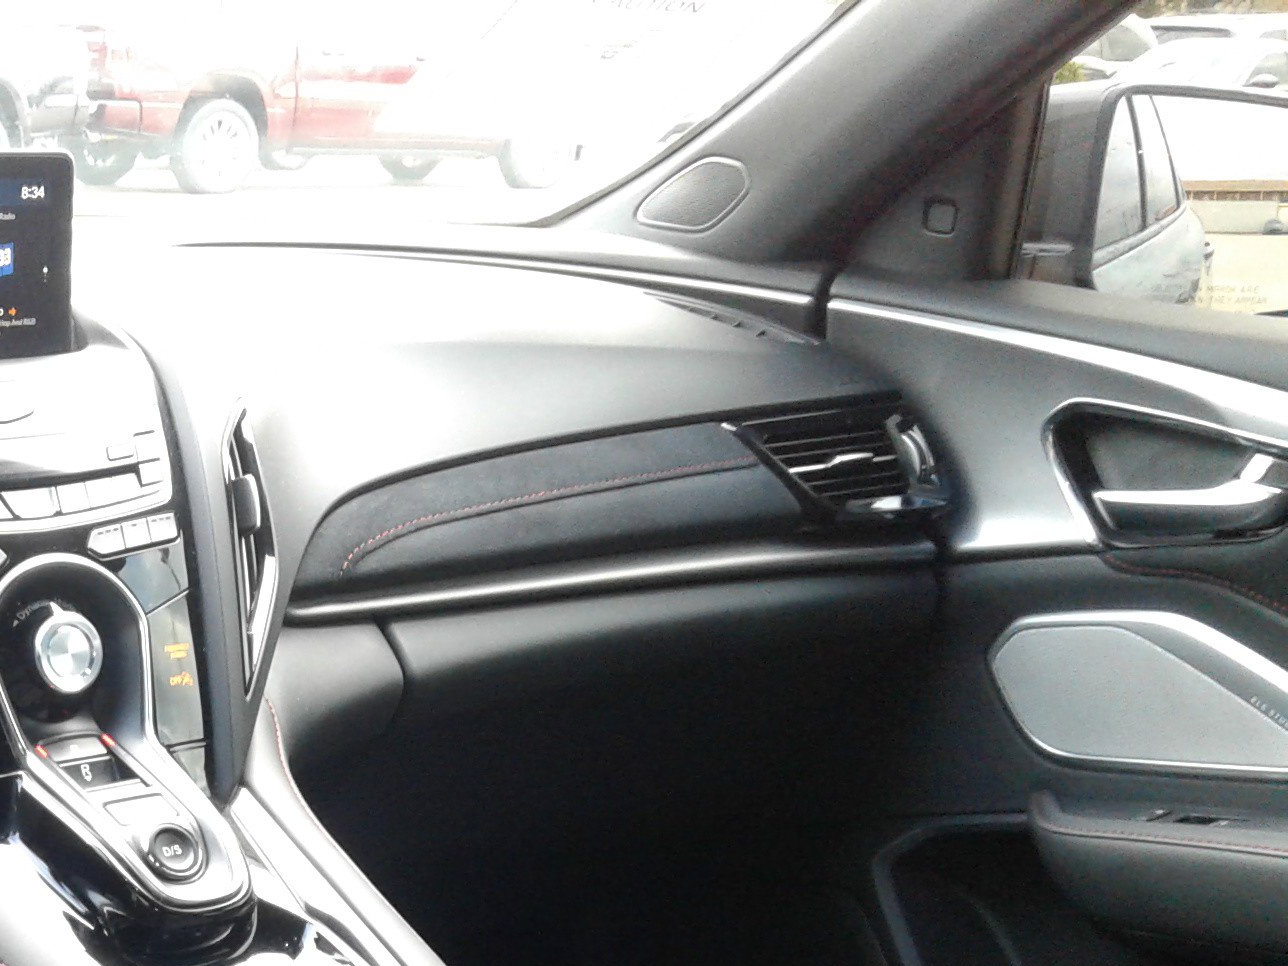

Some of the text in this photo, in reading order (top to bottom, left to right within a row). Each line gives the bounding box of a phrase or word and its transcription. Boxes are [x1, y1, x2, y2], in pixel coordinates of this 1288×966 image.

[21, 185, 45, 199] 8:34
[0, 211, 16, 221] Radio
[162, 844, 182, 857] D/S
